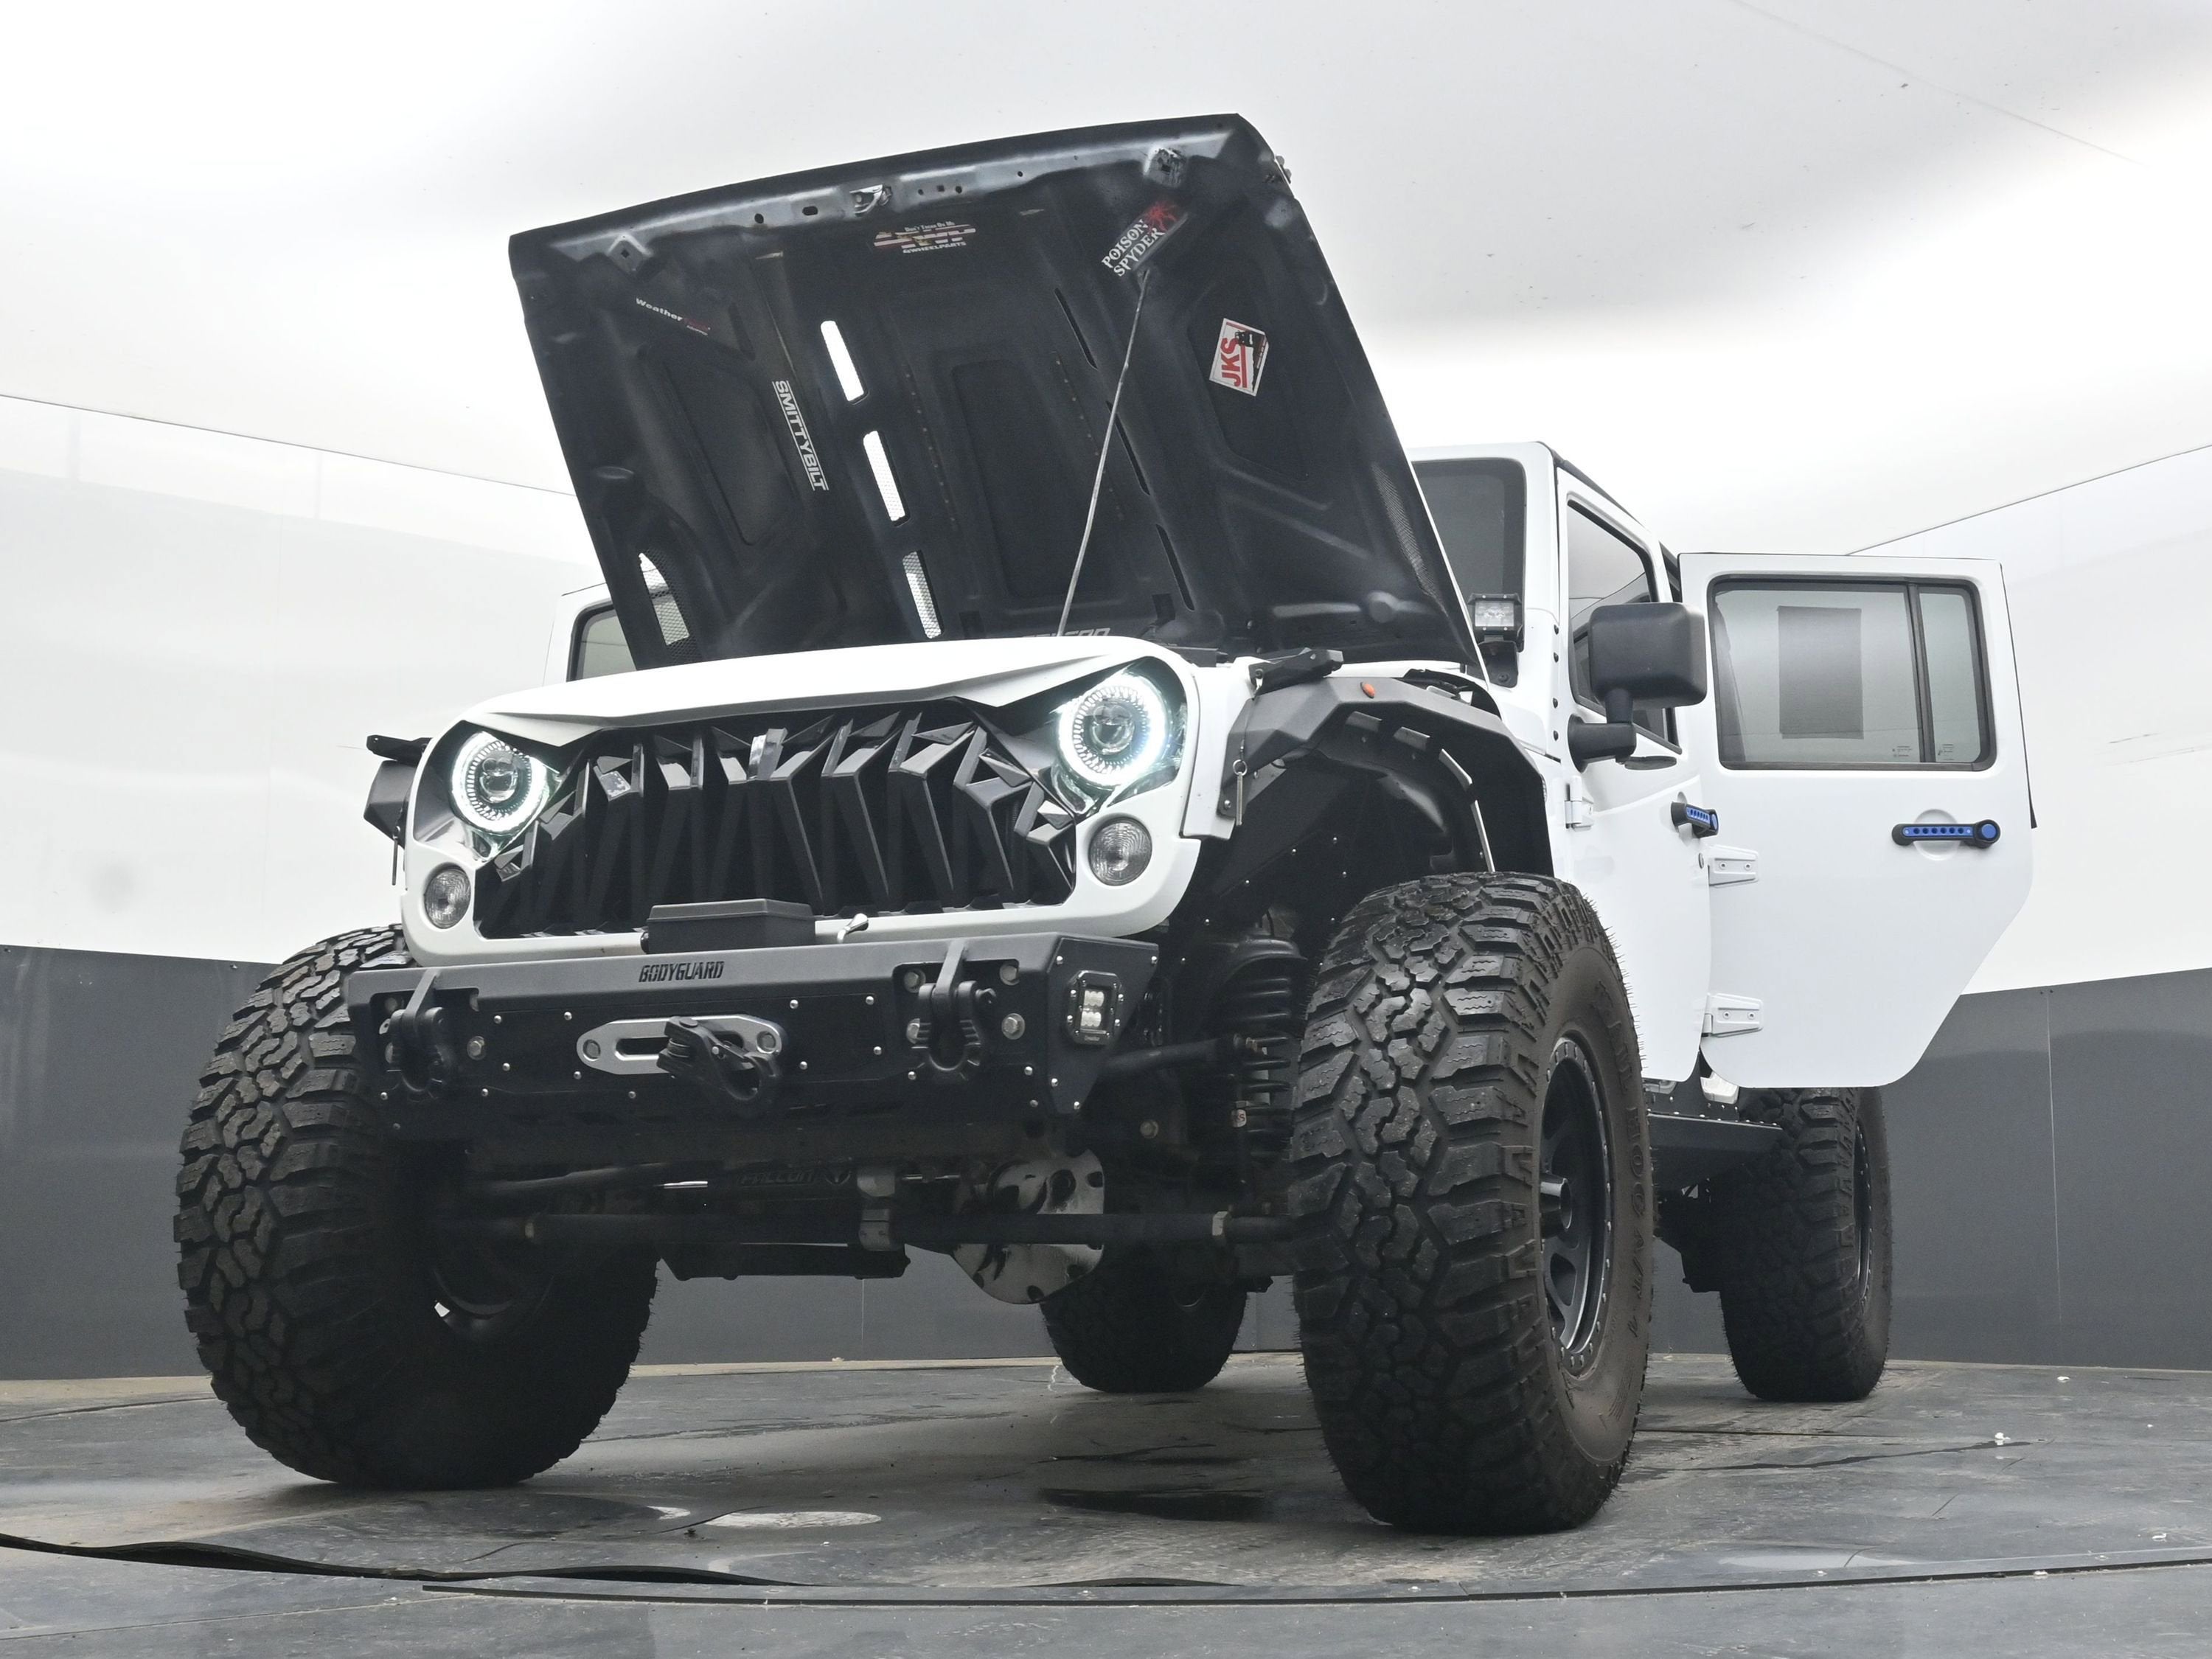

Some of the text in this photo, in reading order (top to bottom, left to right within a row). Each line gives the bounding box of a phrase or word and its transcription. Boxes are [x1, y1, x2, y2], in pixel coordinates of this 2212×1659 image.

[1102, 219, 1148, 268] POISON
[1113, 228, 1166, 276] SPYDER
[636, 297, 683, 321] Weather
[1220, 338, 1241, 386] JKS
[776, 380, 826, 490] SMITTYBILT
[639, 961, 725, 982] BODYGUARD
